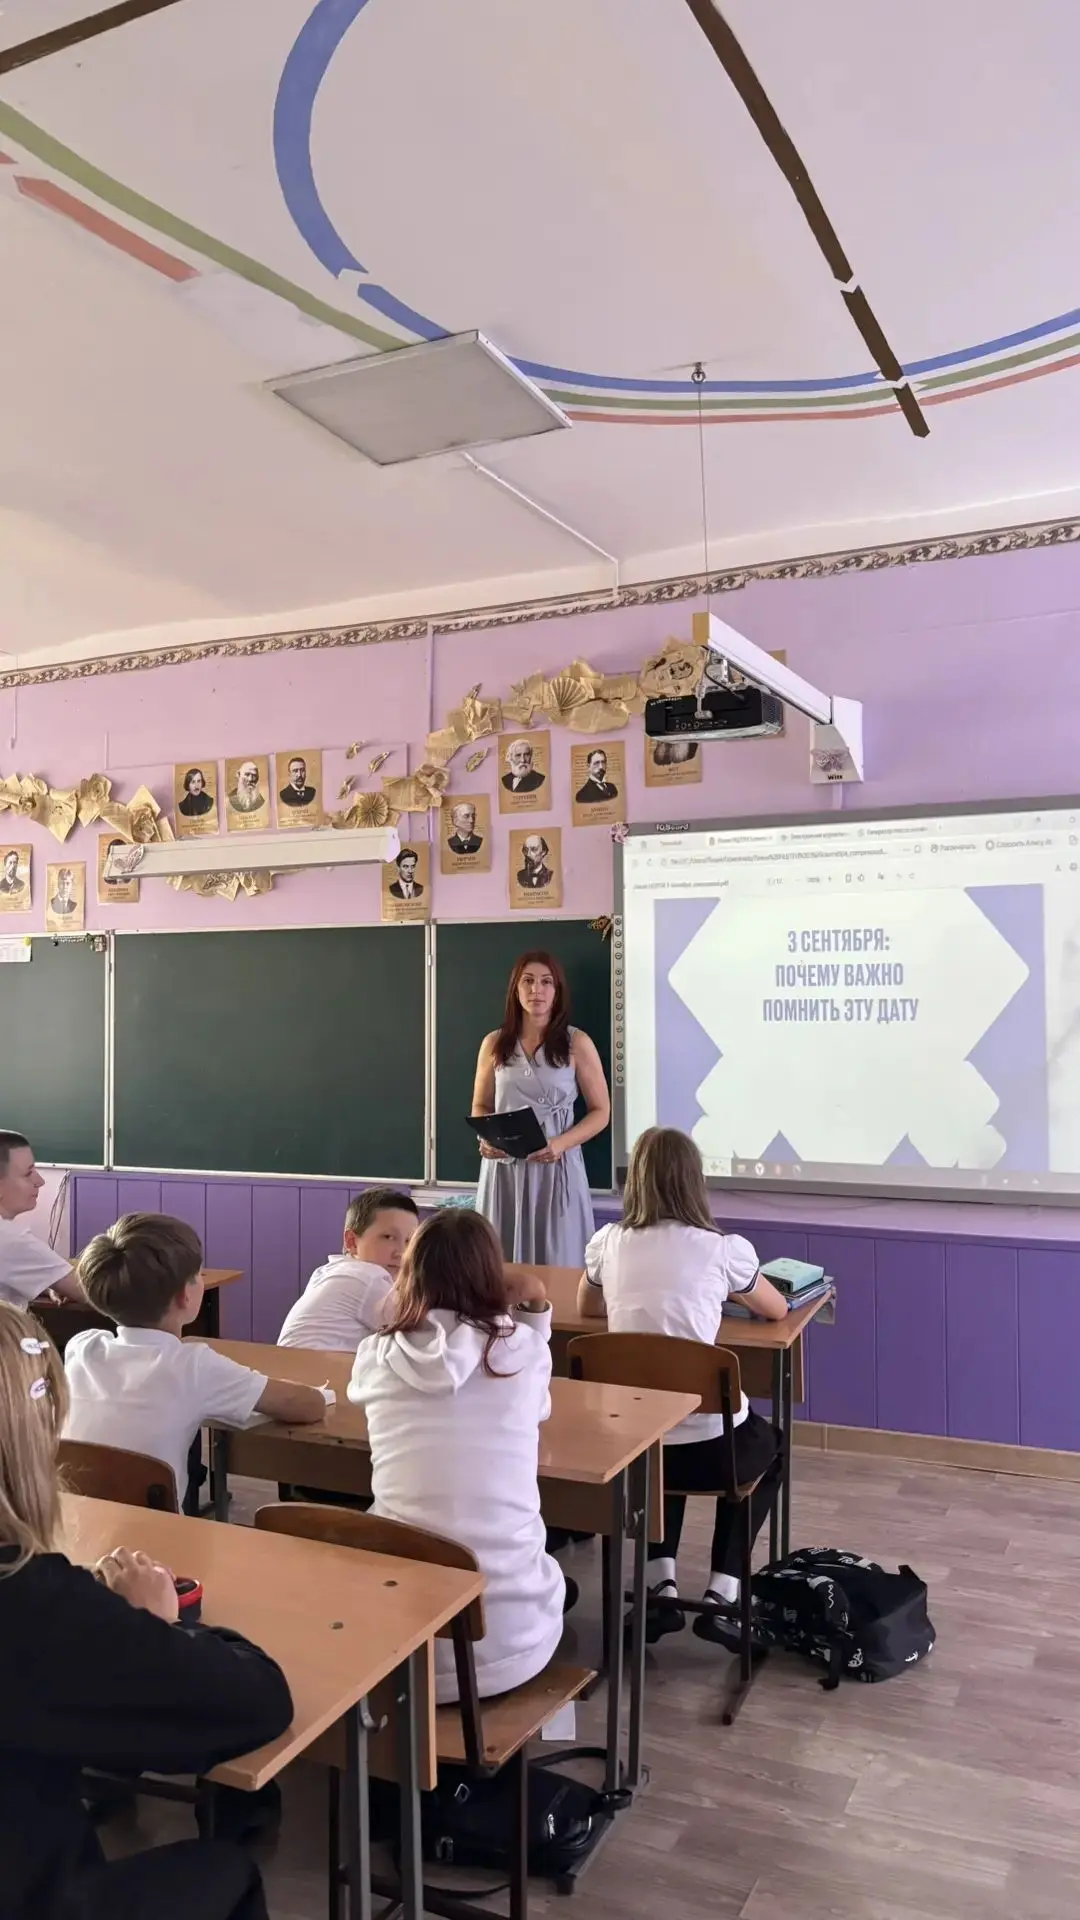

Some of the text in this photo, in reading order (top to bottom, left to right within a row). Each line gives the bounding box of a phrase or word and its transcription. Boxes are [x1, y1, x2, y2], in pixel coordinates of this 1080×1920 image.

[788, 928, 891, 953] 3 СЕНТЯБРЯ:
[775, 963, 904, 987] ПОЧЕМУ ВАЖНО
[763, 998, 919, 1024] ПОМНИТЬ ЭТУ ДАТУ
